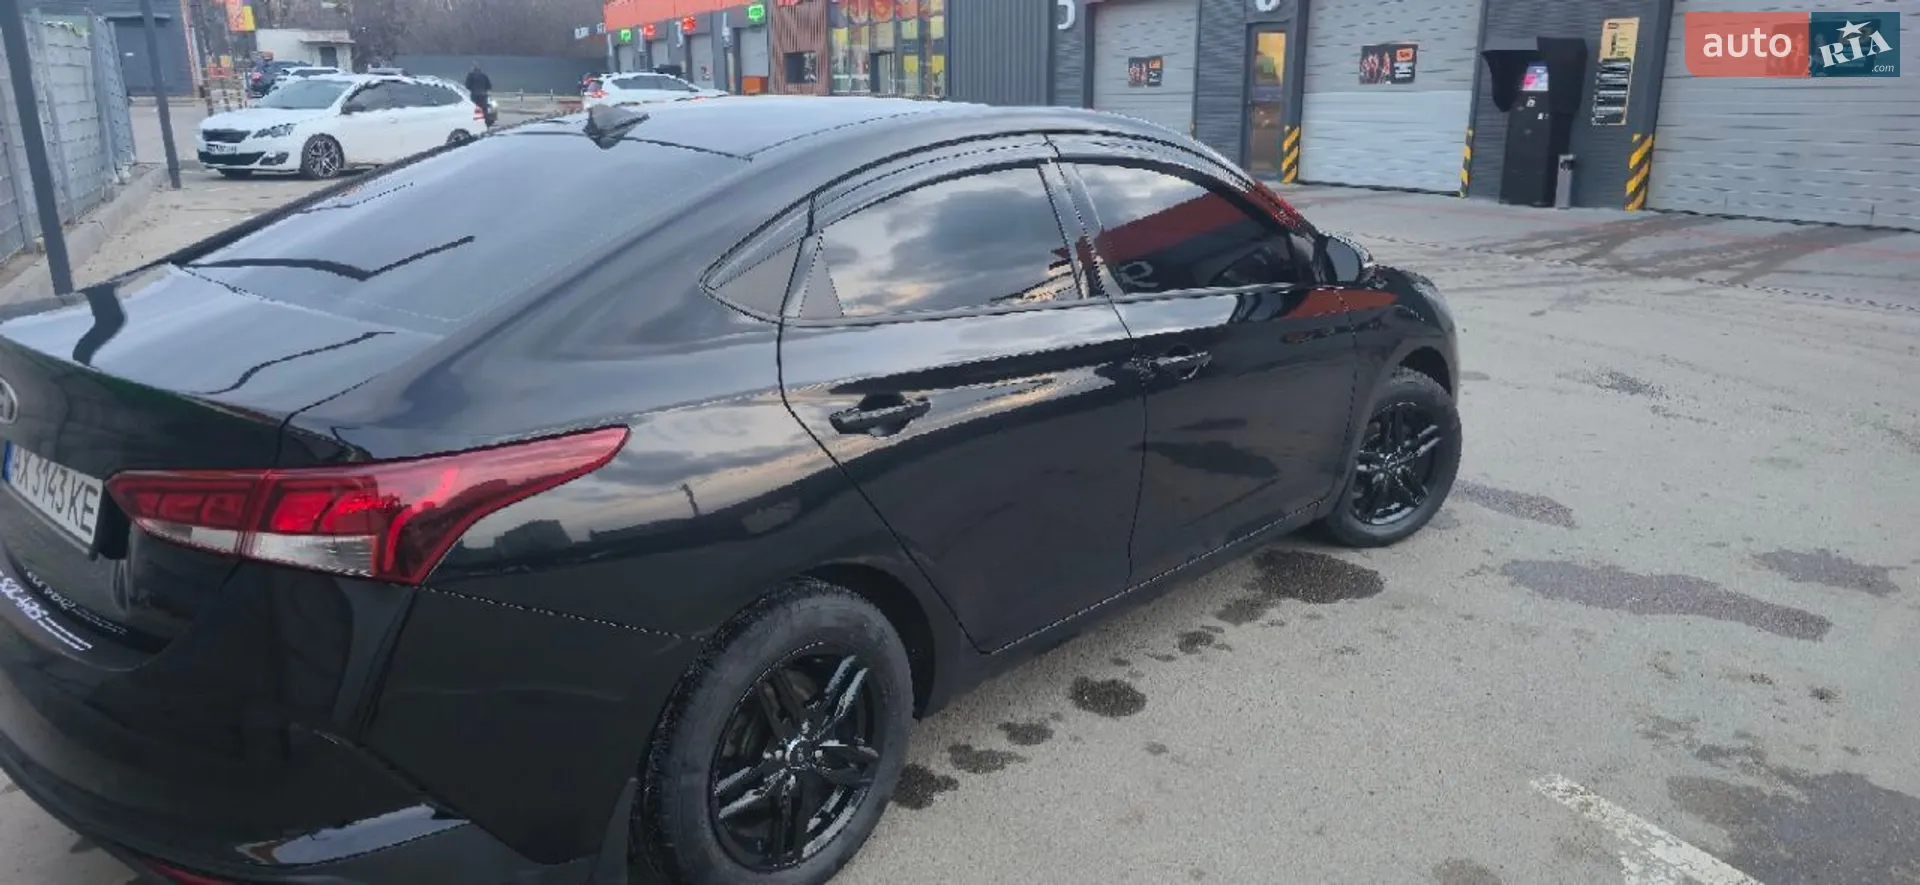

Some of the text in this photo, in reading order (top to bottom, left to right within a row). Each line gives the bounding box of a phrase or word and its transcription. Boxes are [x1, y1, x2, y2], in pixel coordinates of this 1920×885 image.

[13, 448, 99, 536] AX 3143 KE
